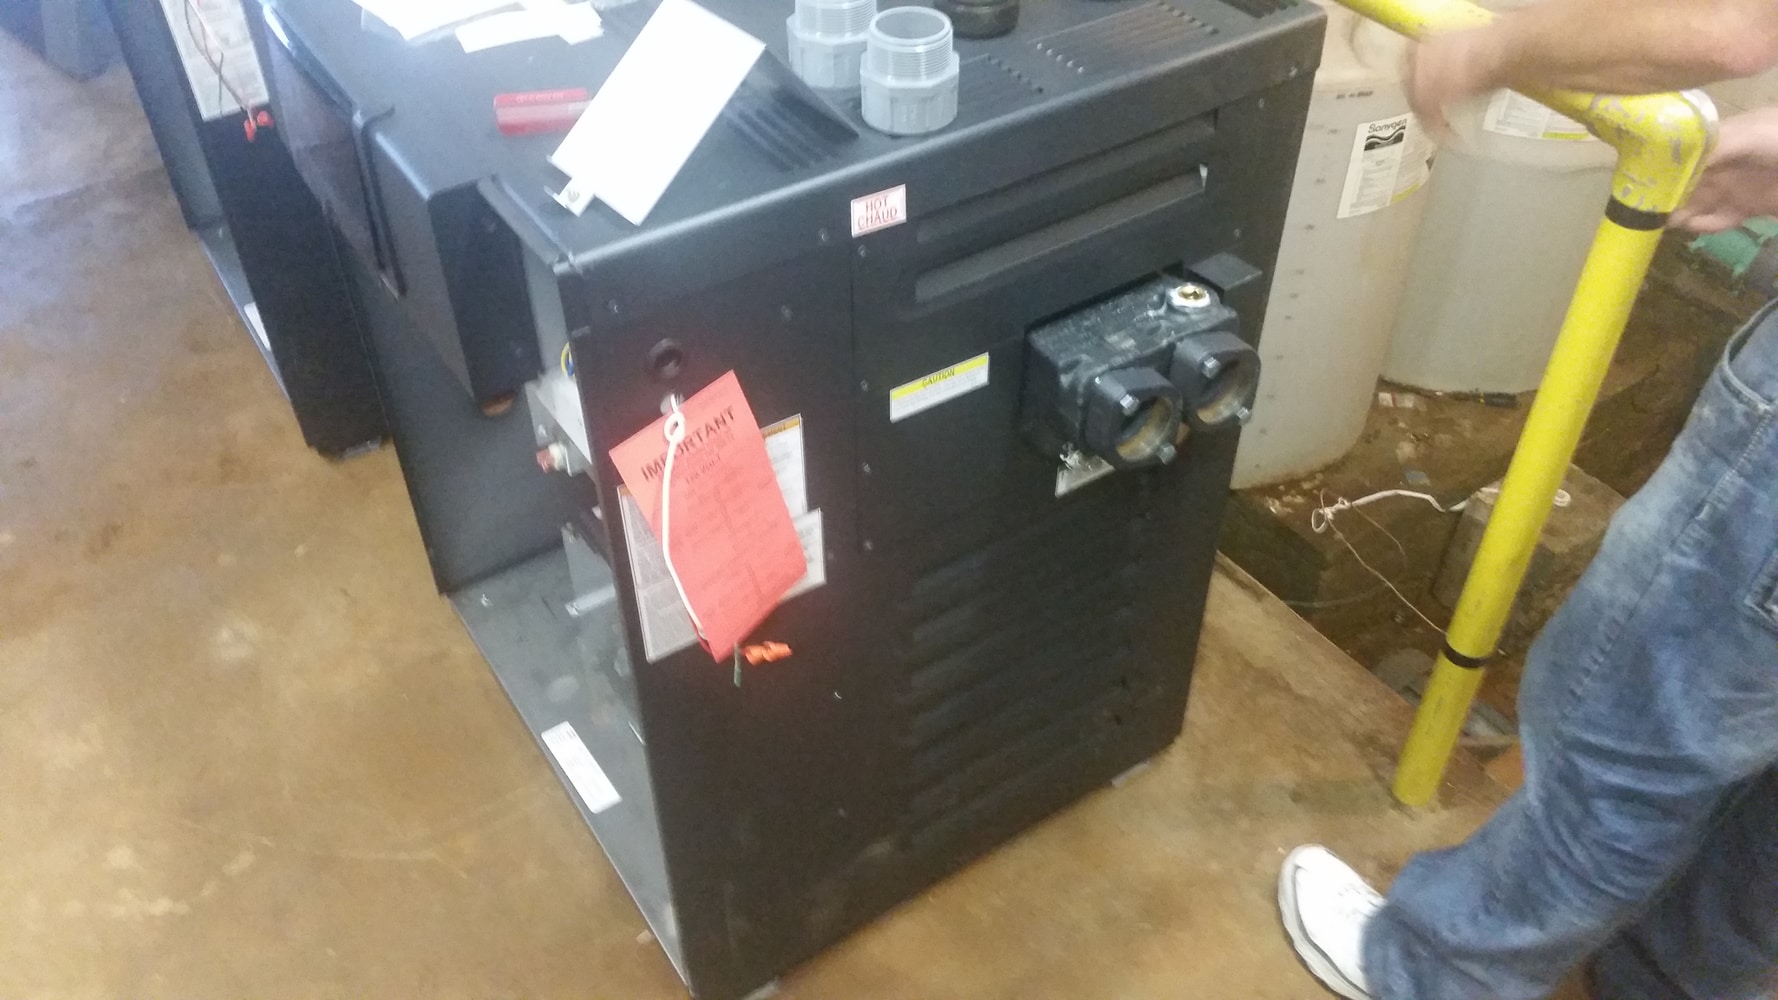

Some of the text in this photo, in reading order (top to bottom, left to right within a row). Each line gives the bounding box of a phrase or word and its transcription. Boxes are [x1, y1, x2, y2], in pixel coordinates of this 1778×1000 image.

[865, 195, 889, 213] HOT
[857, 207, 898, 230] CHAUD
[922, 368, 955, 388] CAUTION
